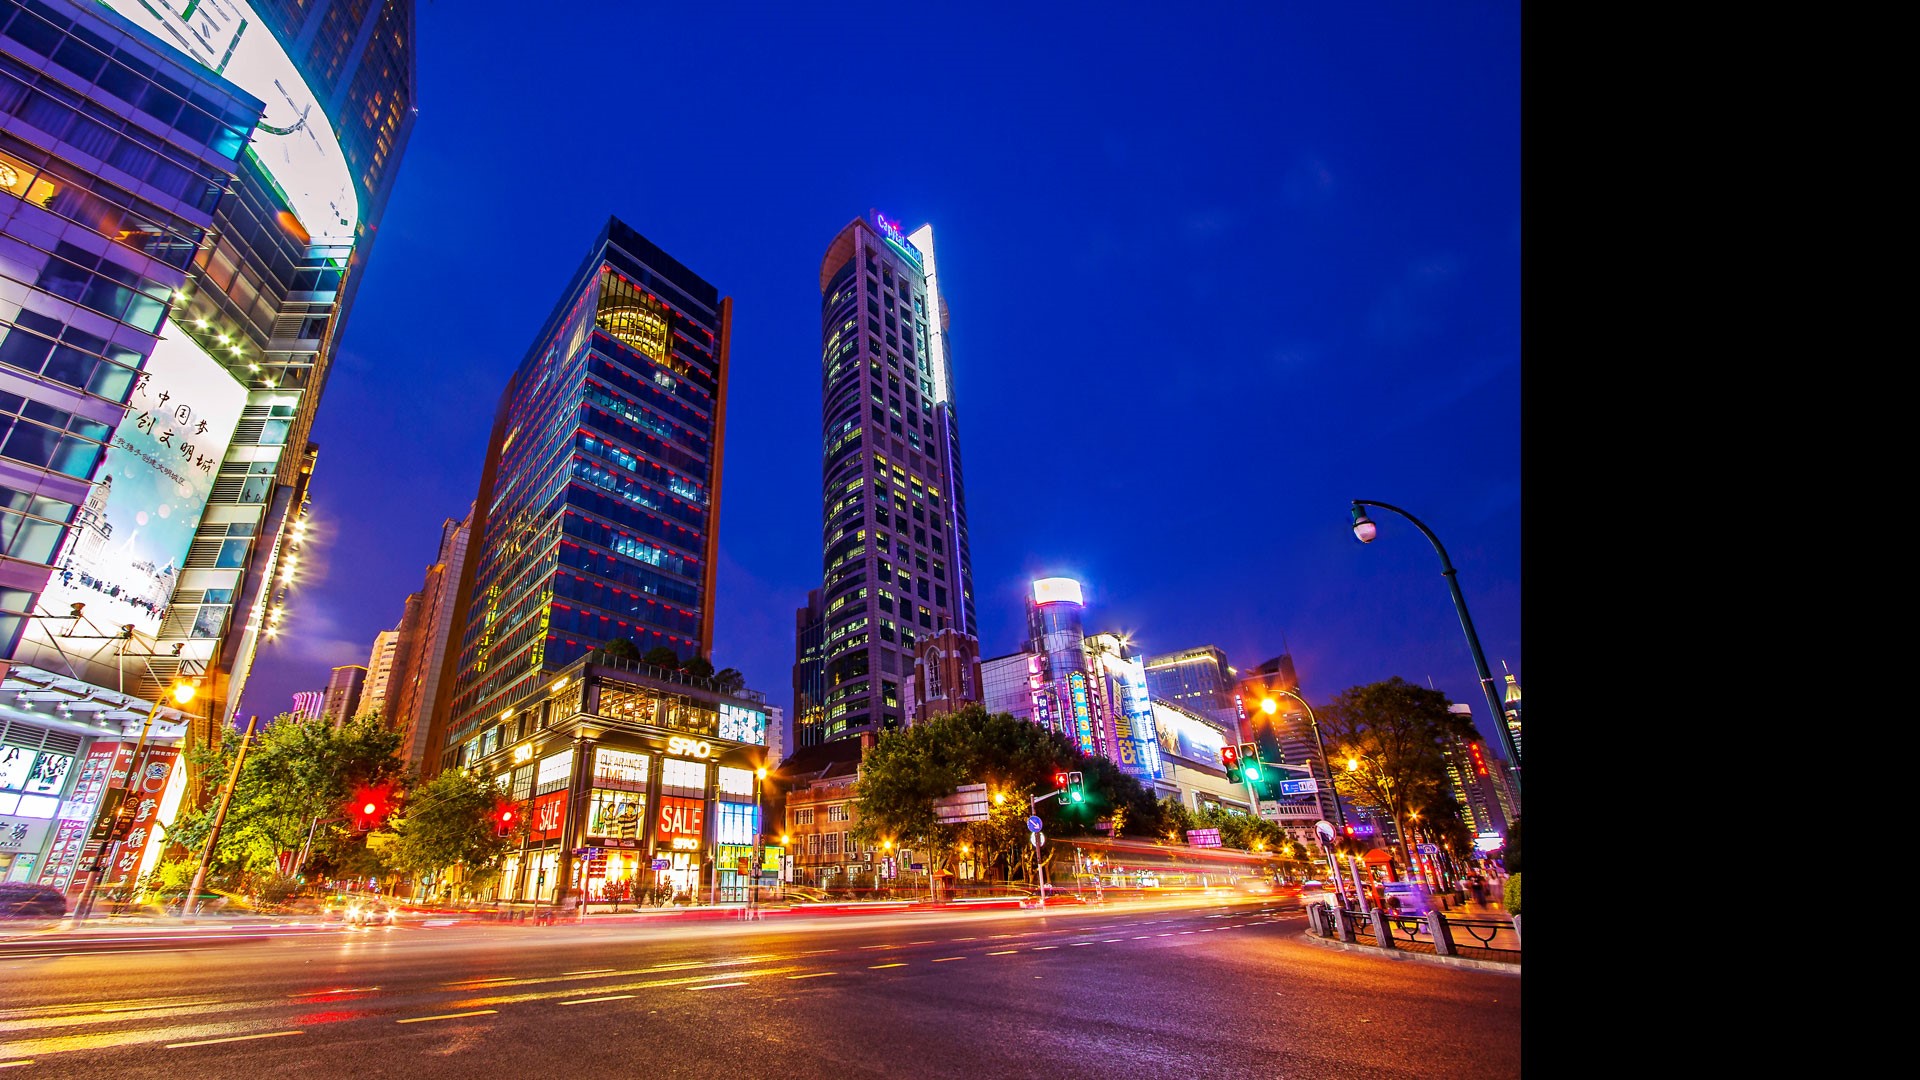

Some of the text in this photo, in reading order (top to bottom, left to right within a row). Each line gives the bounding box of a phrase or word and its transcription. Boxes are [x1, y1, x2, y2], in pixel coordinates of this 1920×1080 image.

[1074, 680, 1091, 752] HERSH
[667, 736, 711, 758] SPAO
[600, 753, 643, 770] CLEARANCE
[539, 800, 561, 831] SALE
[661, 805, 702, 835] SALE
[673, 838, 698, 850] SPAO
